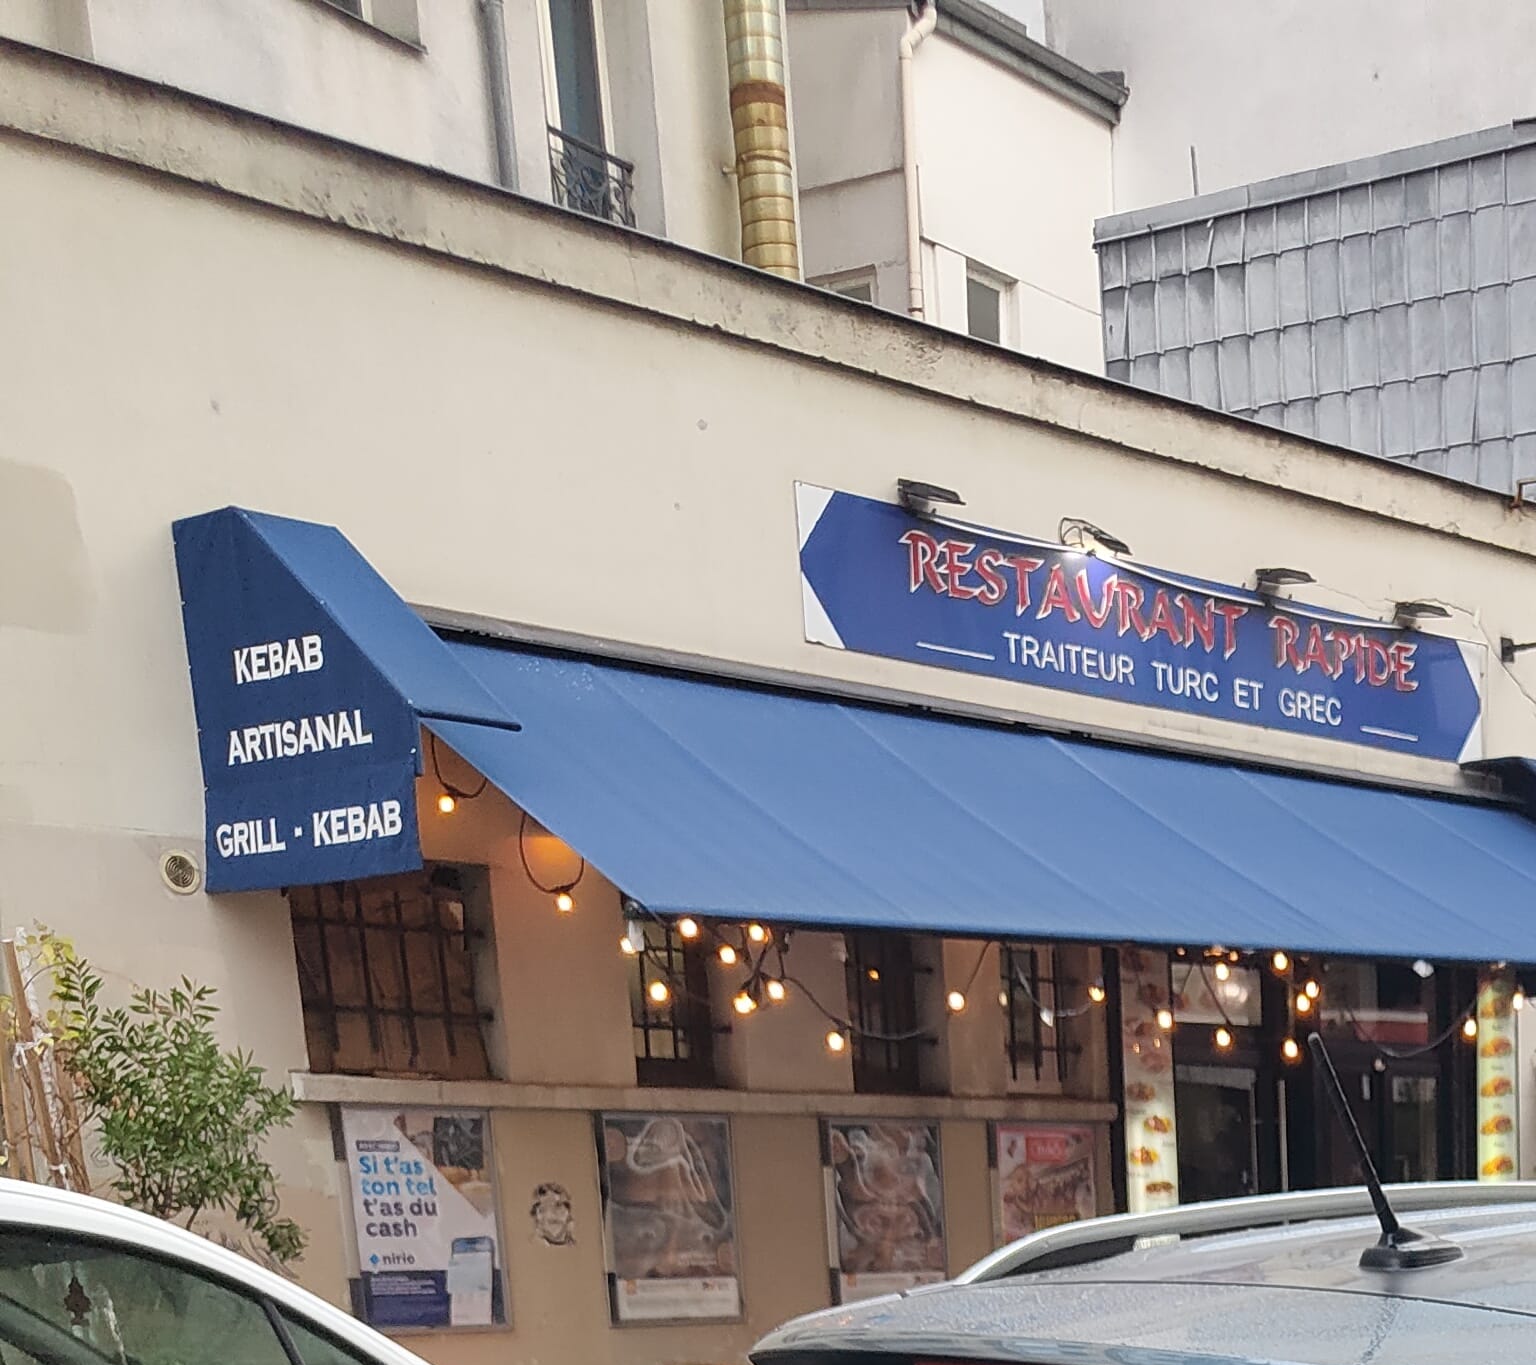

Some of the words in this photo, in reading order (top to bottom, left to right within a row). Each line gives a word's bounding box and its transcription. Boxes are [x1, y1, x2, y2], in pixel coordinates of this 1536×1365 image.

[899, 530, 1249, 661] RESTAURANT
[1268, 615, 1419, 692] RAPIDE
[233, 634, 324, 685] KEBAB
[1003, 631, 1135, 686] TRAITEUR
[1151, 661, 1220, 703] TURC
[1233, 678, 1265, 711] ET
[1278, 687, 1342, 727] GREC
[227, 709, 373, 766] ARTISANAL
[215, 817, 286, 858] GRILL
[312, 799, 402, 847] KEBAB
[359, 1155, 378, 1175] Si
[362, 1178, 400, 1195] ton
[406, 1176, 437, 1196] tel
[363, 1198, 404, 1217] t'as
[409, 1198, 438, 1217] du
[366, 1218, 417, 1237] cash
